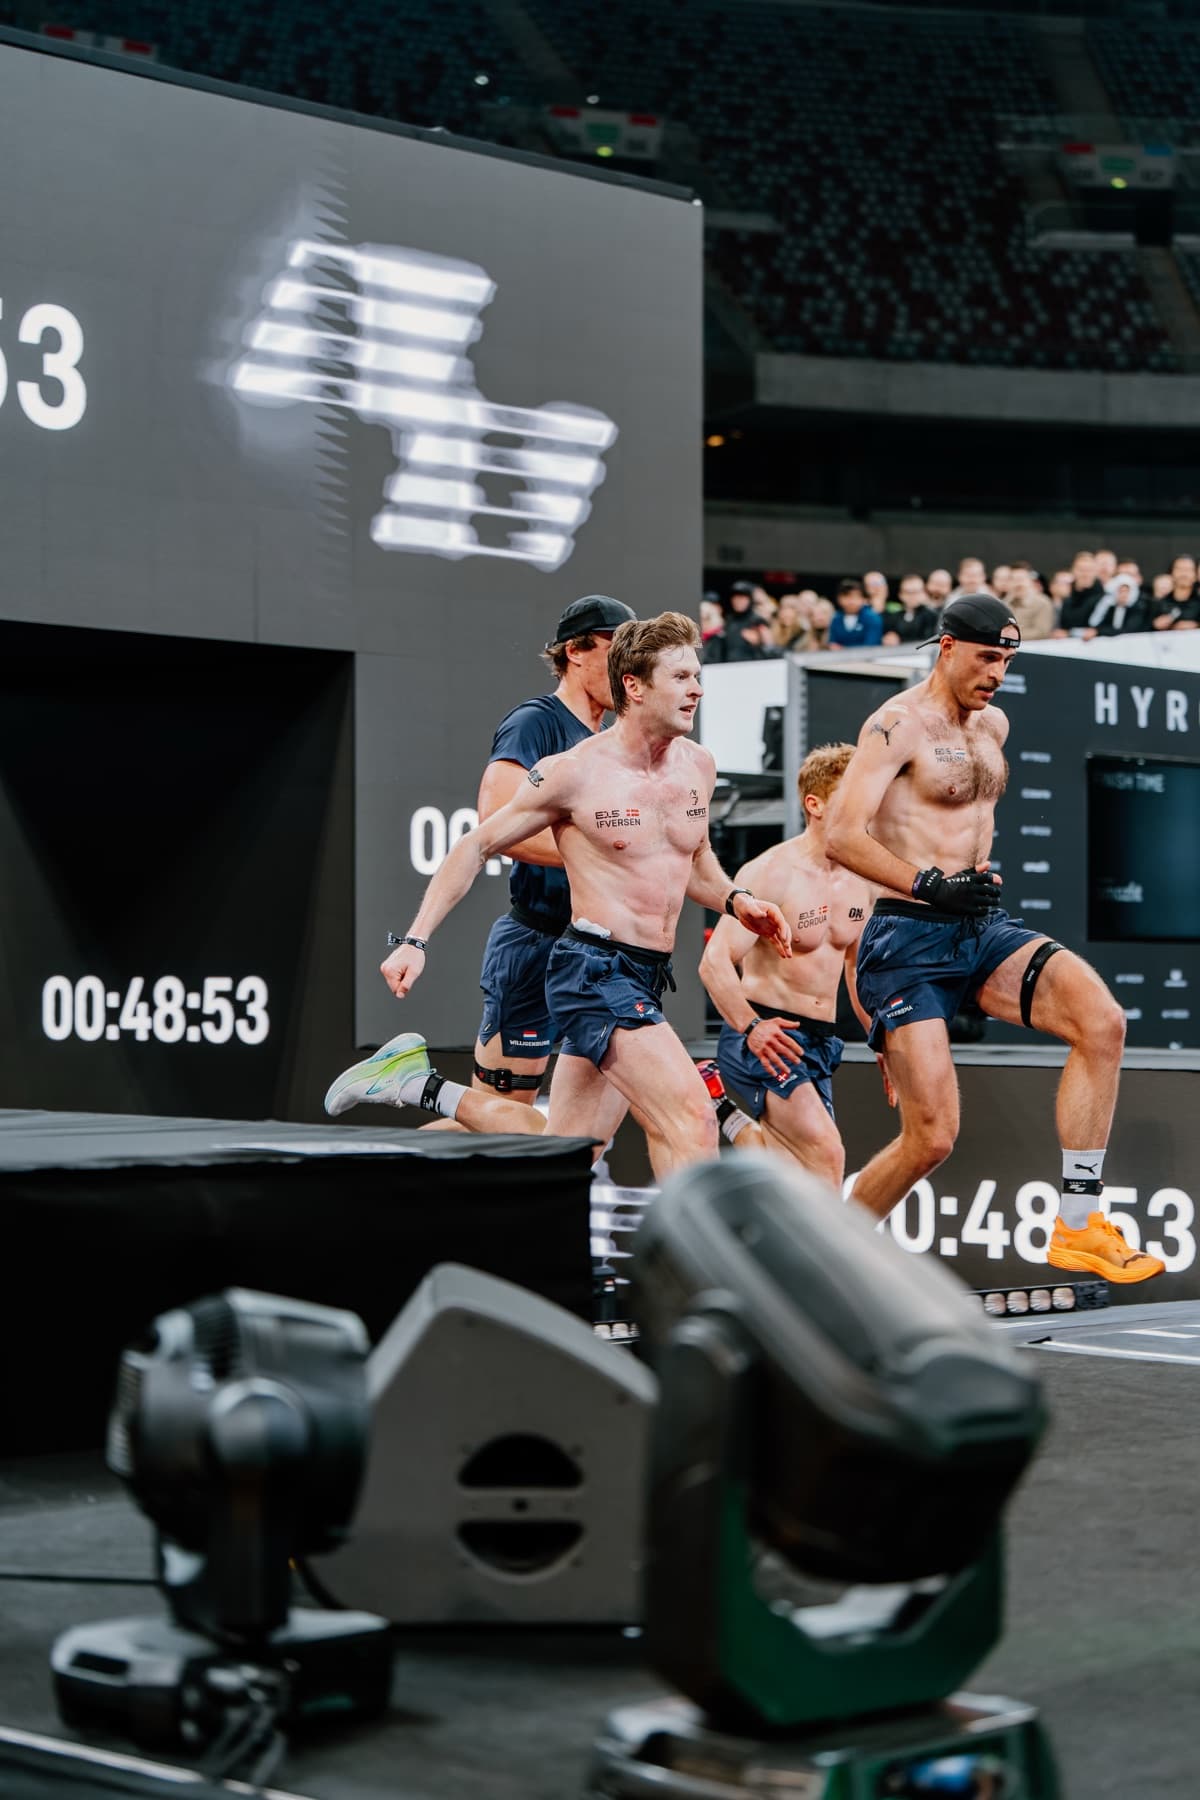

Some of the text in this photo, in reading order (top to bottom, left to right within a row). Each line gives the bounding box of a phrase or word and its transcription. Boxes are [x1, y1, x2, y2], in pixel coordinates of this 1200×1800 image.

[0, 298, 87, 430] 3
[1095, 681, 1200, 732] HYR
[596, 818, 641, 829] IFVERSEN
[797, 914, 828, 930] CORDUA
[42, 975, 270, 1045] 00:48:53
